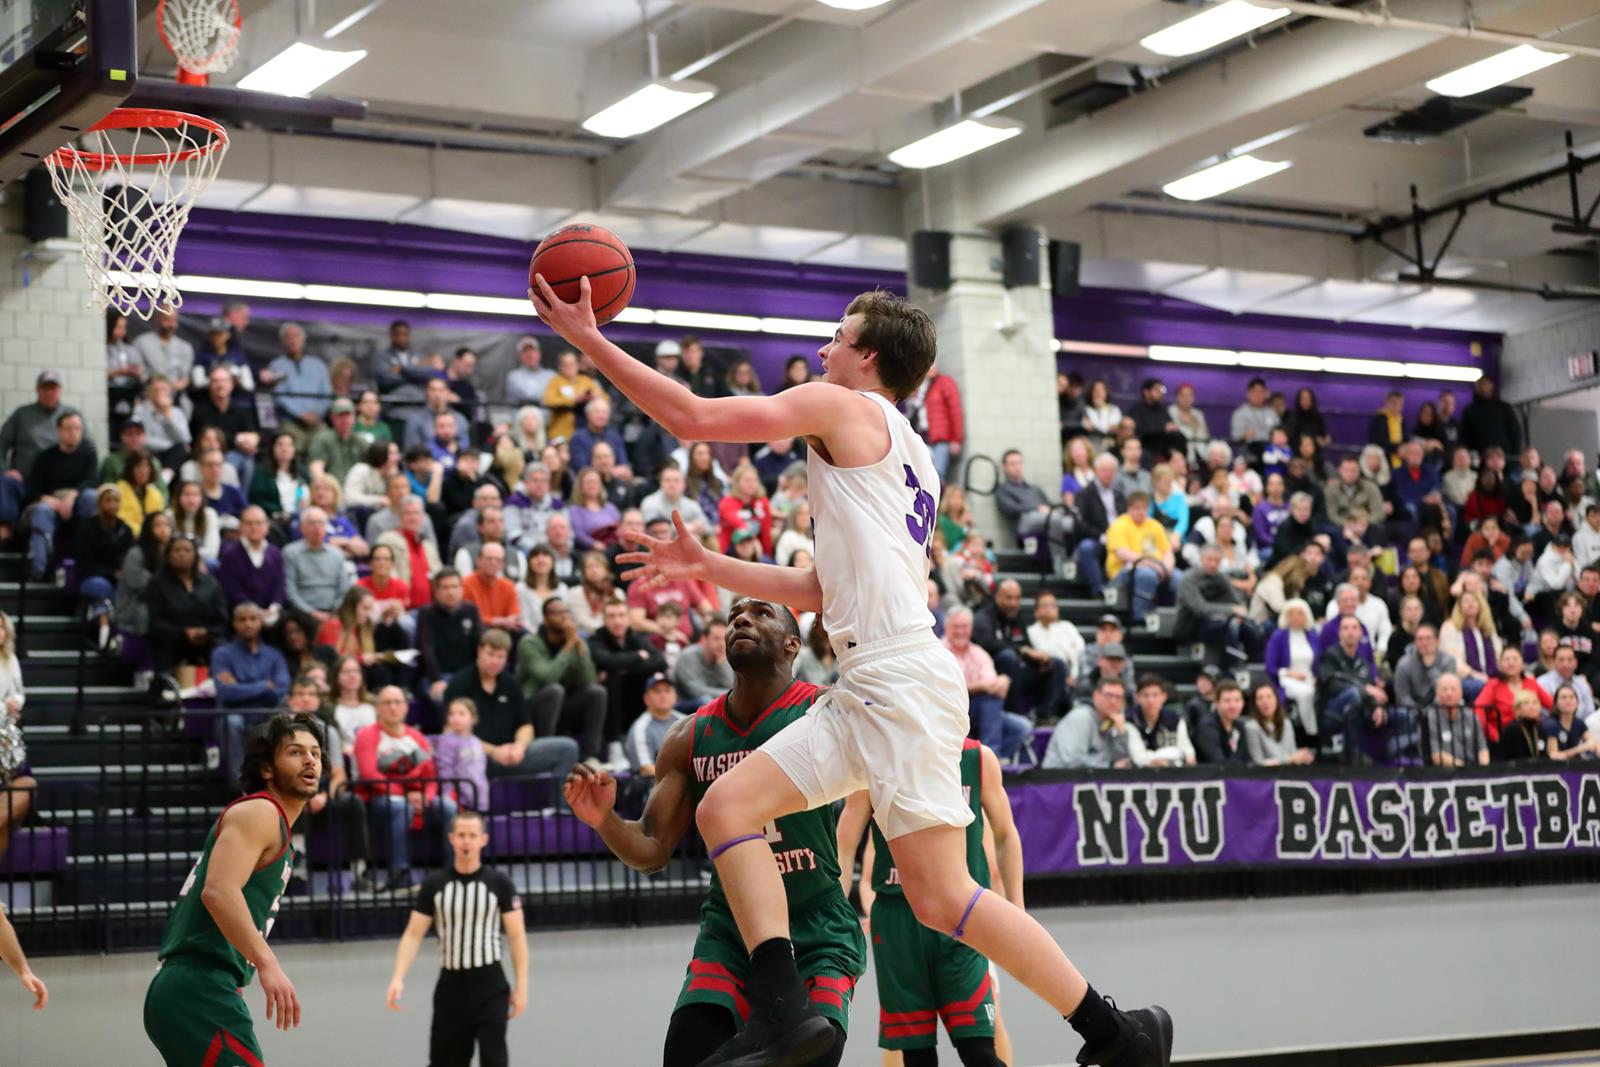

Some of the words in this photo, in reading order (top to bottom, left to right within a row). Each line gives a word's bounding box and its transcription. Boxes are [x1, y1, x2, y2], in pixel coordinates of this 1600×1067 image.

[693, 749, 754, 783] WASH
[1073, 781, 1225, 865] NYU
[1275, 774, 1600, 860] BASKETBA
